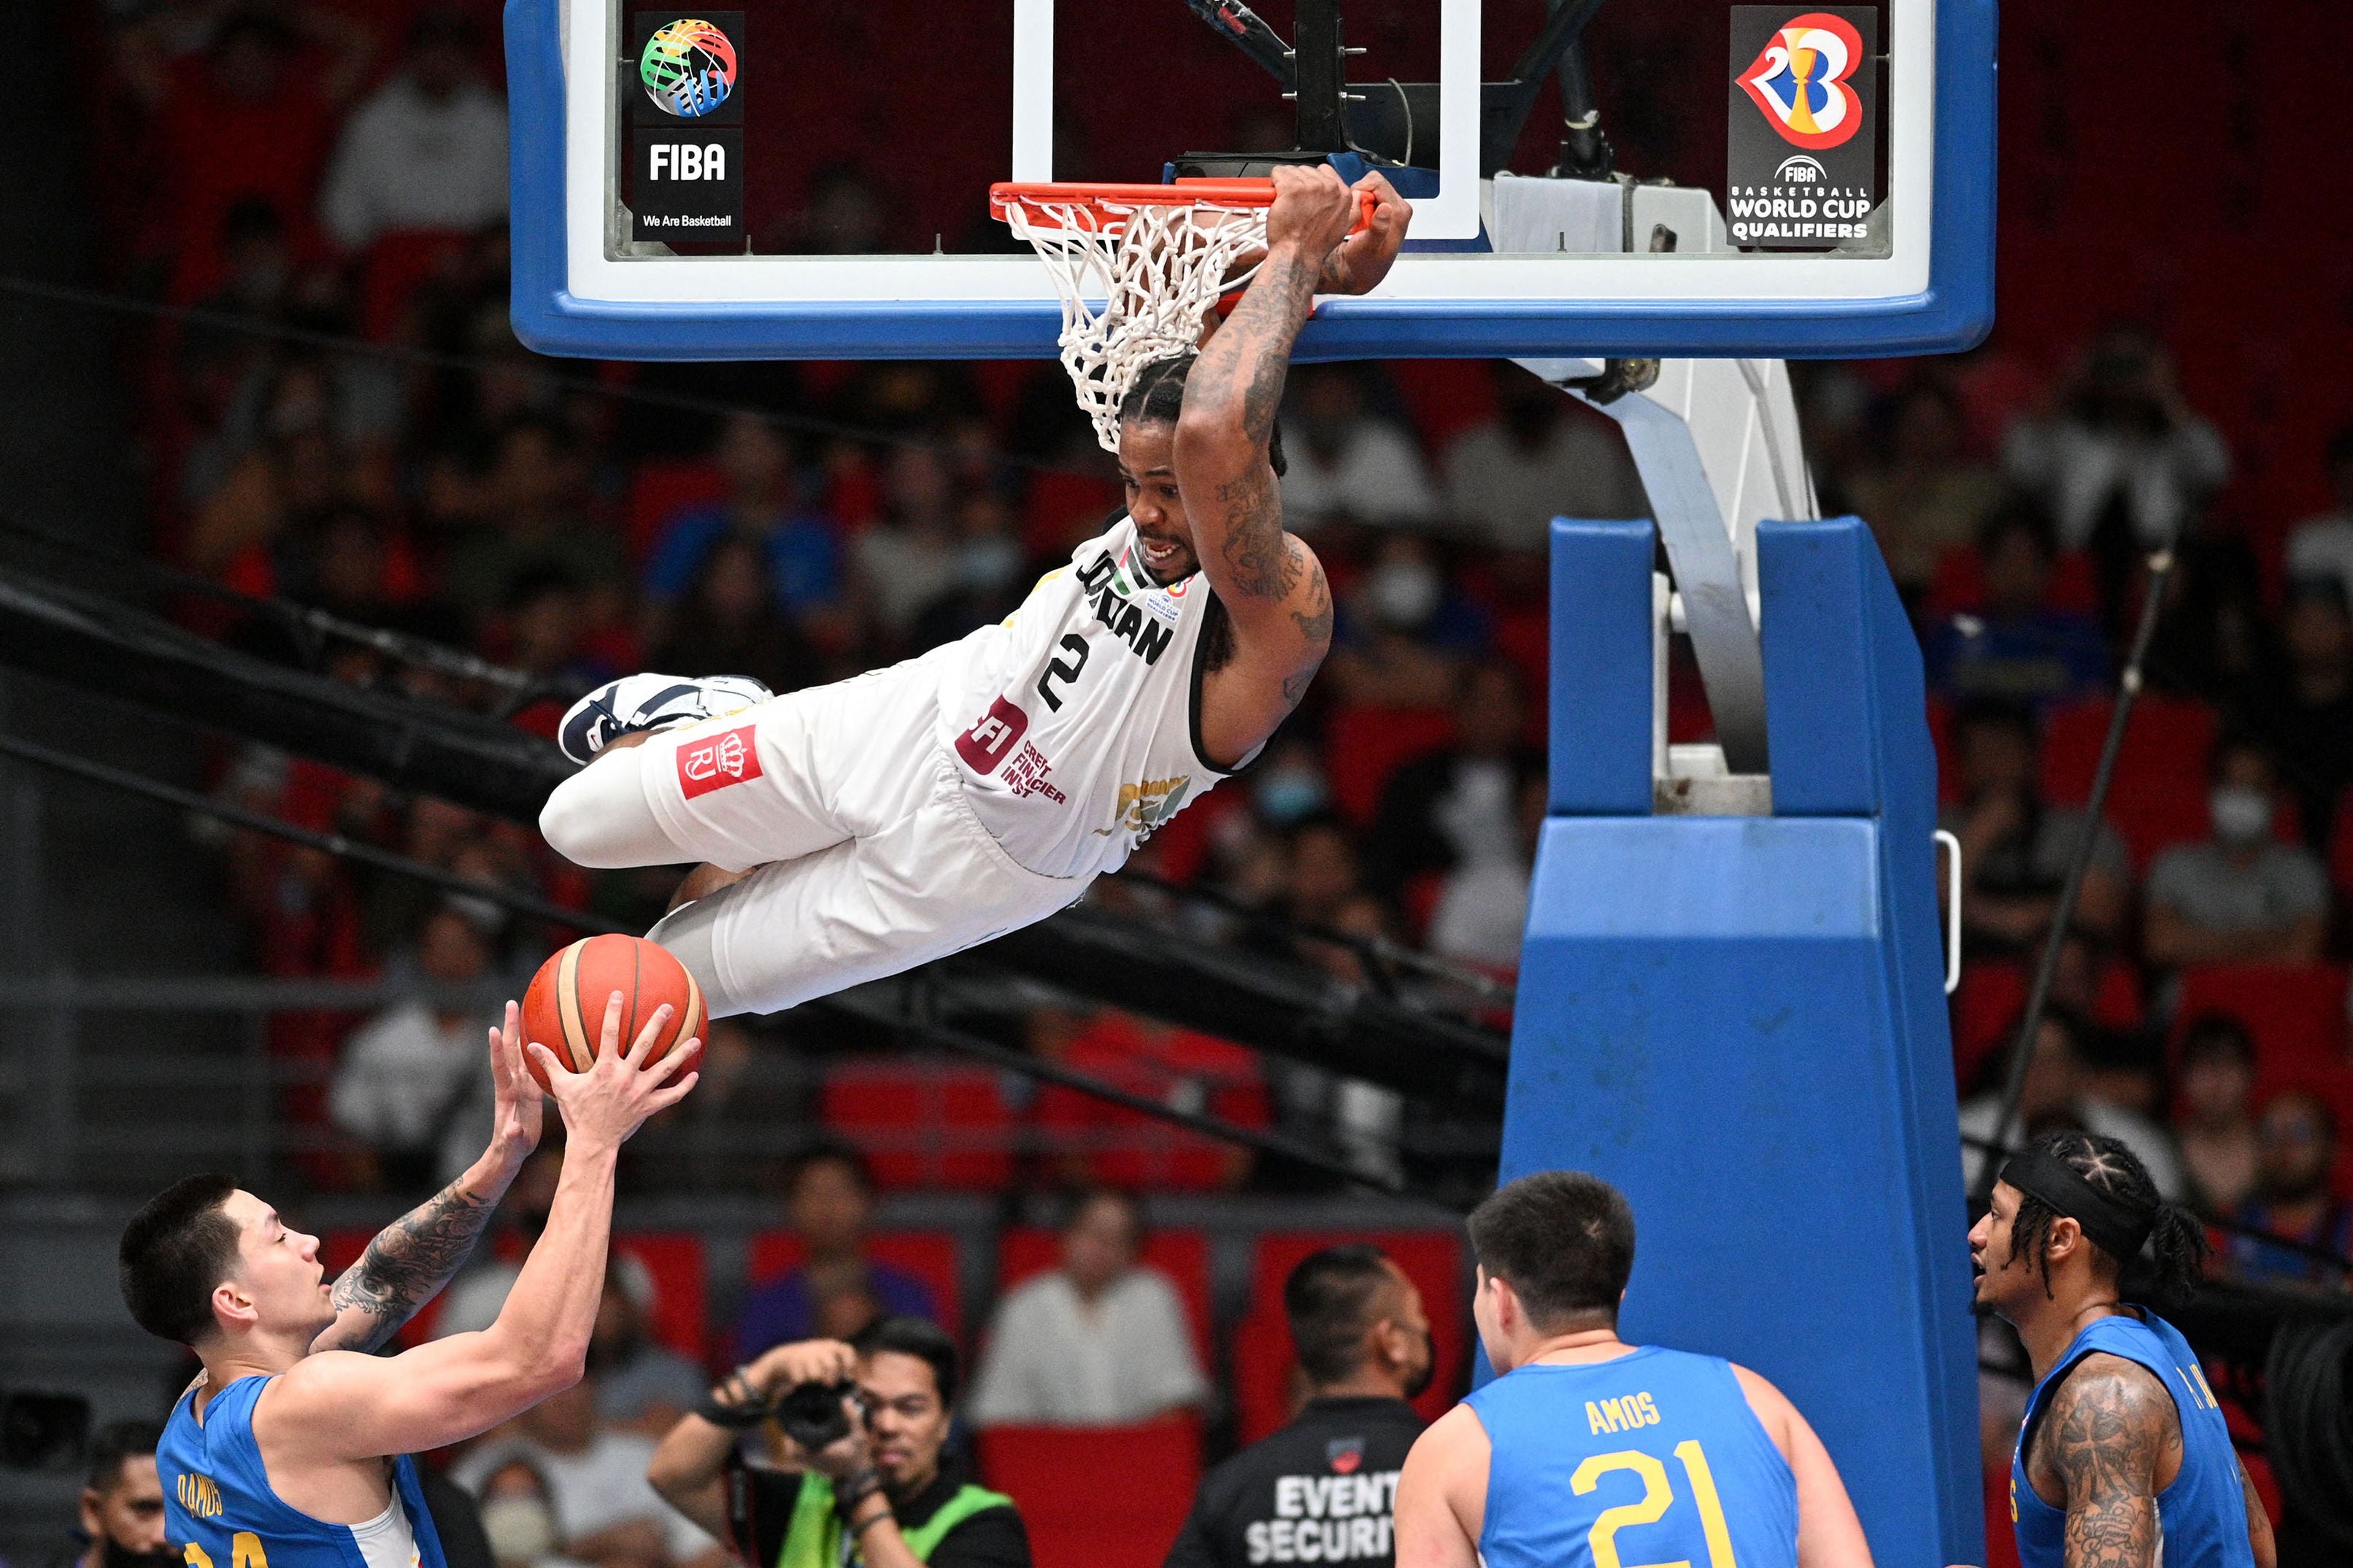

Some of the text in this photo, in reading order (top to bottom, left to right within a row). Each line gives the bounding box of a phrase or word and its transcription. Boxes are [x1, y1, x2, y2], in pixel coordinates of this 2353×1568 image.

[650, 143, 725, 181] FIBA
[1784, 166, 1817, 182] FIBA
[1730, 198, 1871, 219] WORLD CUP
[1731, 186, 1867, 197] BASKETBALL
[643, 215, 731, 226] We Are Basketball
[1732, 222, 1868, 240] QUALIFIERS
[1076, 549, 1174, 665] JODAN
[1037, 633, 1090, 714] 2
[1584, 1391, 1662, 1435] AMOS
[1569, 1439, 1738, 1568] 21
[1244, 1514, 1394, 1565] SECURI
